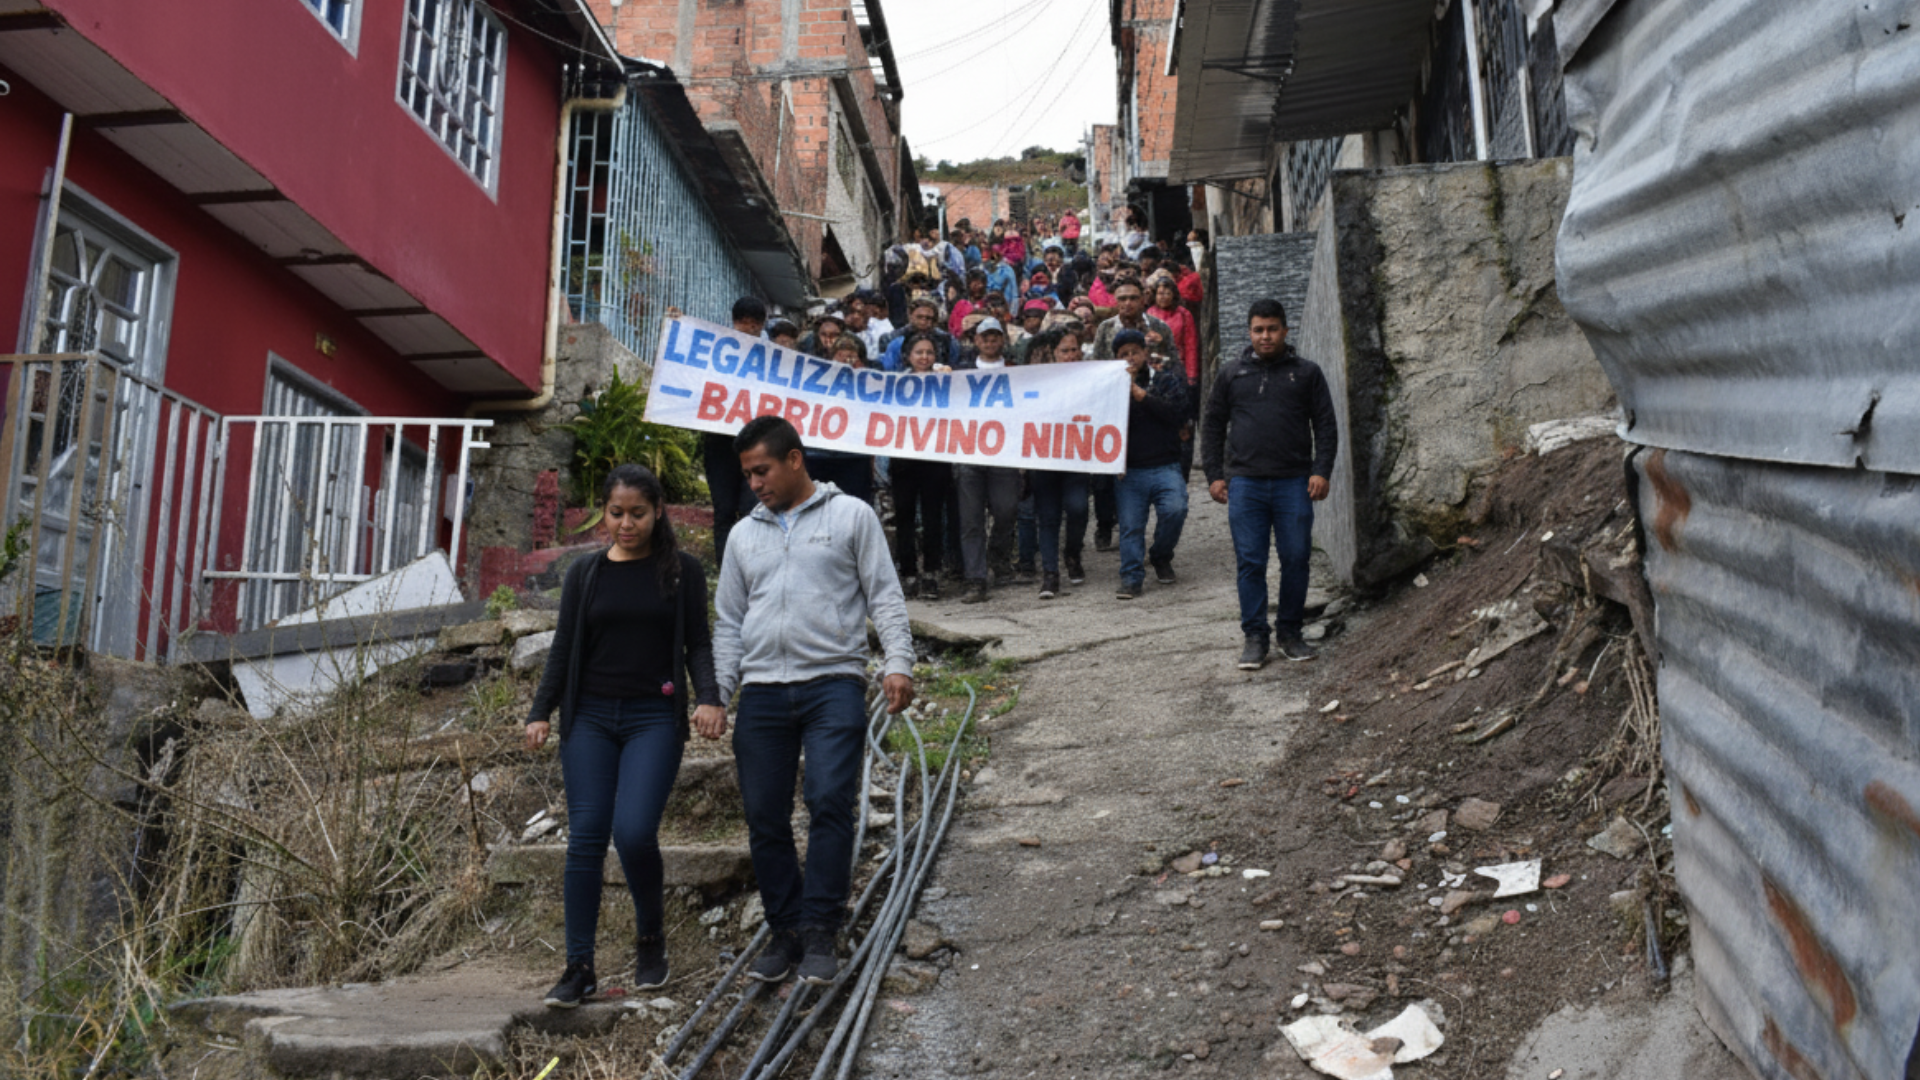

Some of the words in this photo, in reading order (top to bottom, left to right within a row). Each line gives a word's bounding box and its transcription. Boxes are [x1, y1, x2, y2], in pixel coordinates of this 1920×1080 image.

[663, 321, 952, 411] LEGALIZACION
[865, 413, 1005, 455] DIVINO
[1022, 416, 1122, 463] NIÑO
